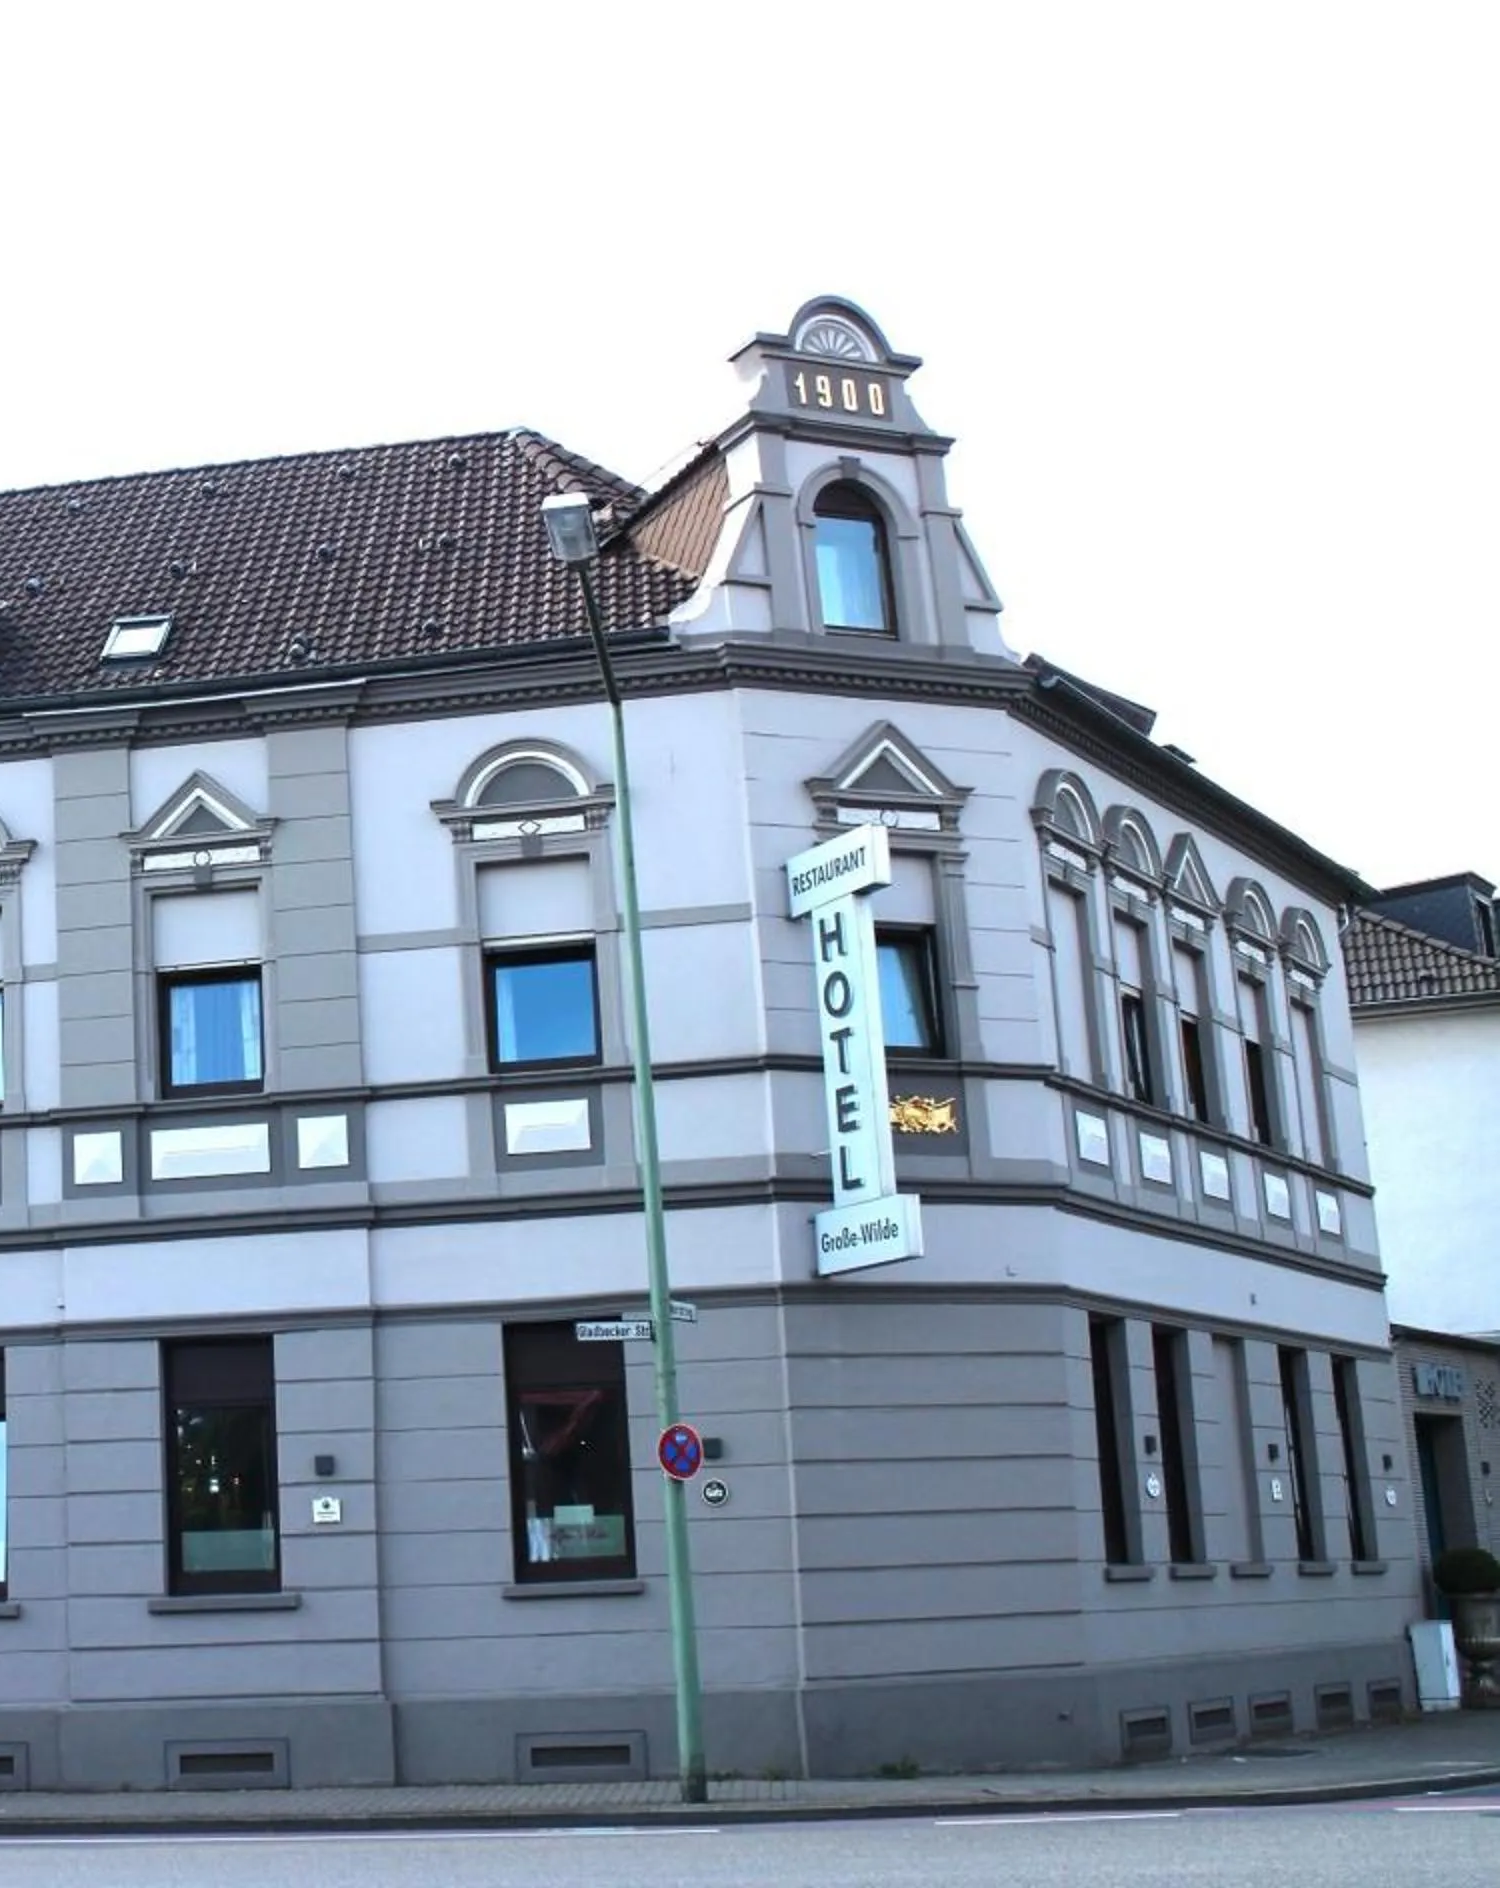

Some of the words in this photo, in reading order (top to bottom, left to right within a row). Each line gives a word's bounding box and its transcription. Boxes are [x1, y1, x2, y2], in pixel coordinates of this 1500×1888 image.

[793, 371, 885, 416] 1900
[791, 846, 866, 897] RESTAURANT
[819, 911, 864, 1191] HOTEL
[821, 1217, 899, 1253] Große-Wilde
